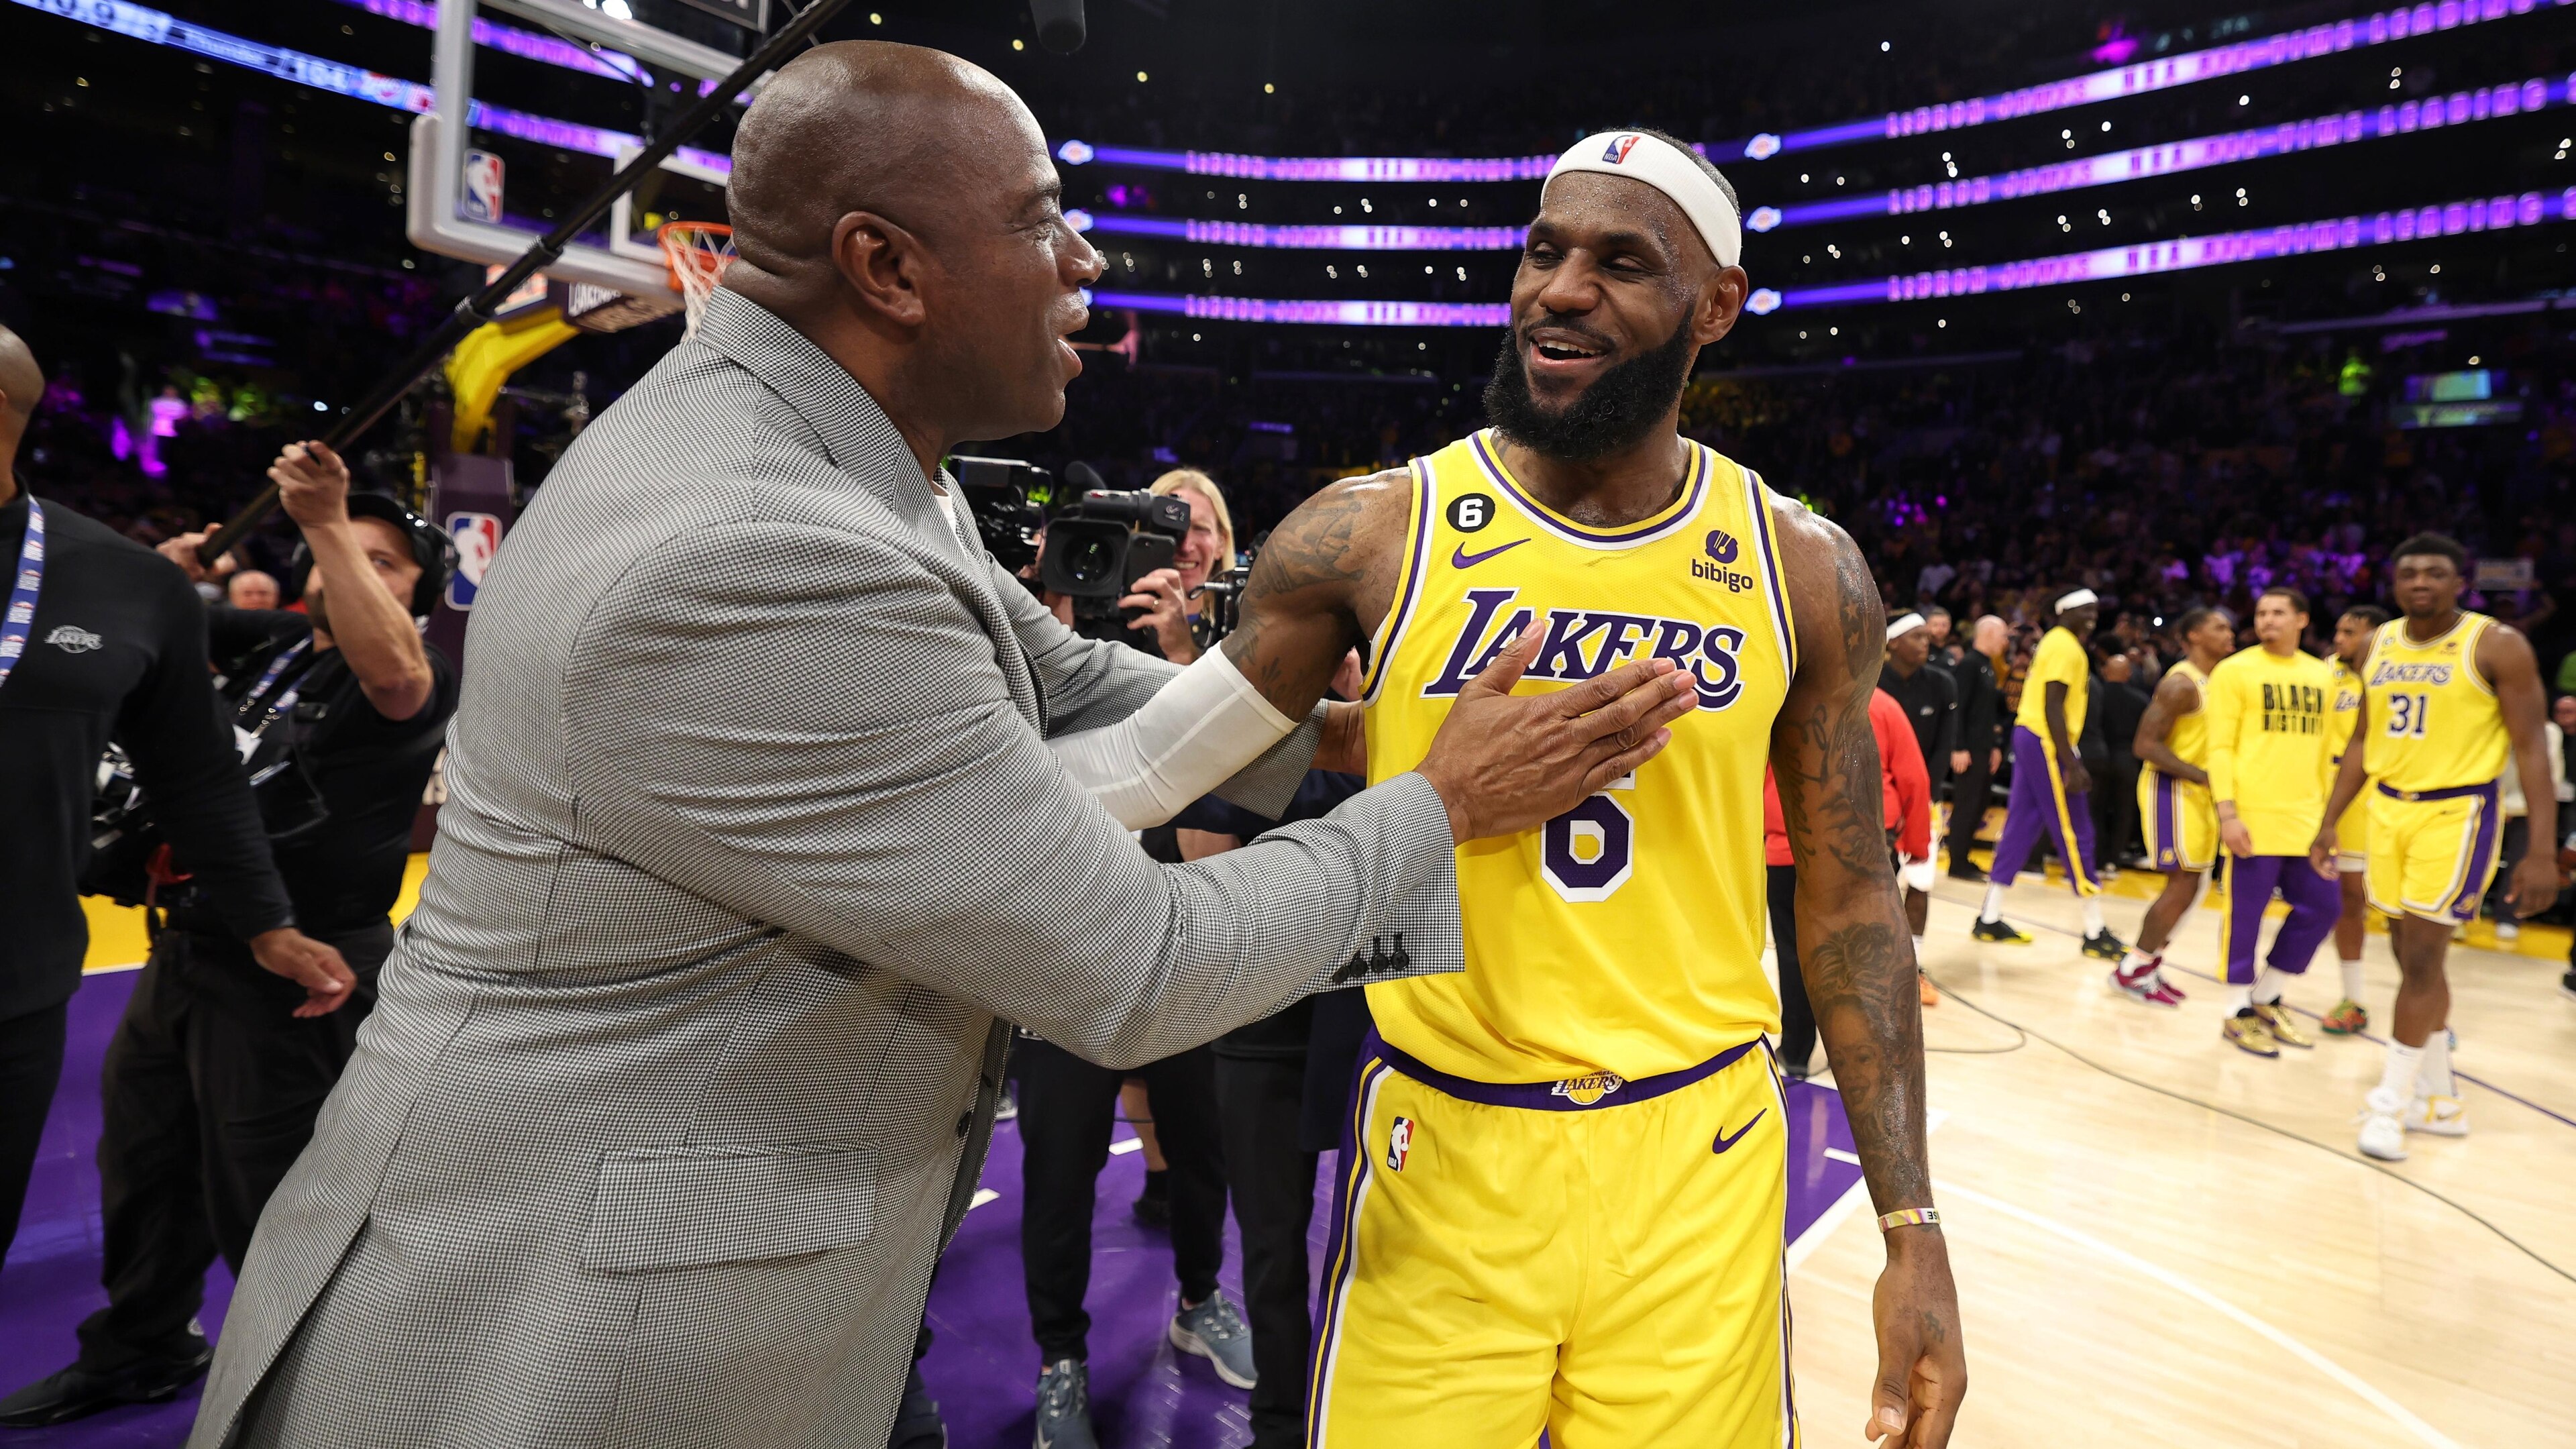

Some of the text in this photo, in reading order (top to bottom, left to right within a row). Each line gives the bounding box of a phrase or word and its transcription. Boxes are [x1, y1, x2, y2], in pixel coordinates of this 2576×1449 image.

[1605, 153, 1617, 161] NBA
[1458, 498, 1483, 528] 6
[1692, 558, 1753, 593] bibigo
[2387, 694, 2428, 735] 31
[1555, 1075, 1617, 1094] LAKERS
